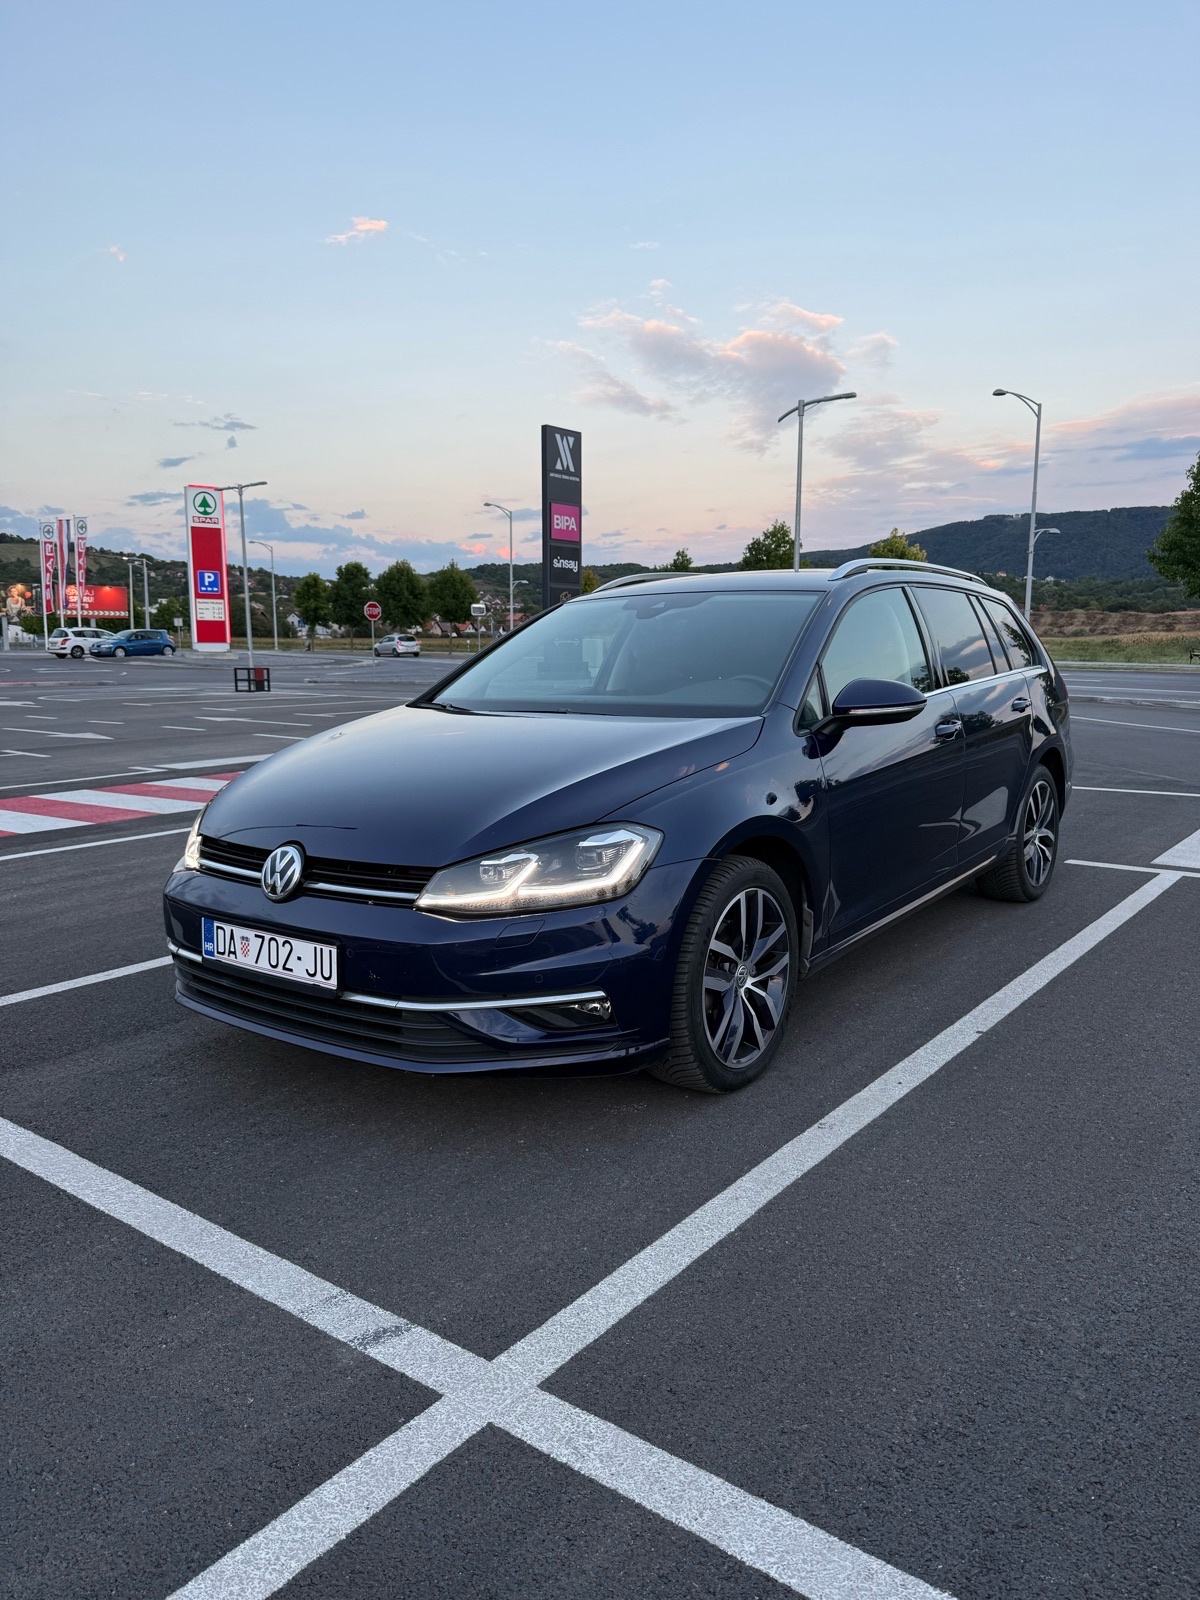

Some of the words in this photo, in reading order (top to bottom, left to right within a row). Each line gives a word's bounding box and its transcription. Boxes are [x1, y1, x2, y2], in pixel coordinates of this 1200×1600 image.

[192, 516, 219, 524] SPAR
[554, 514, 577, 531] BIPA
[553, 556, 578, 573] sinsay
[204, 572, 215, 586] P
[366, 607, 380, 615] STOP
[204, 941, 214, 952] HR
[216, 925, 238, 959] DA
[254, 933, 333, 981] 702-JU
